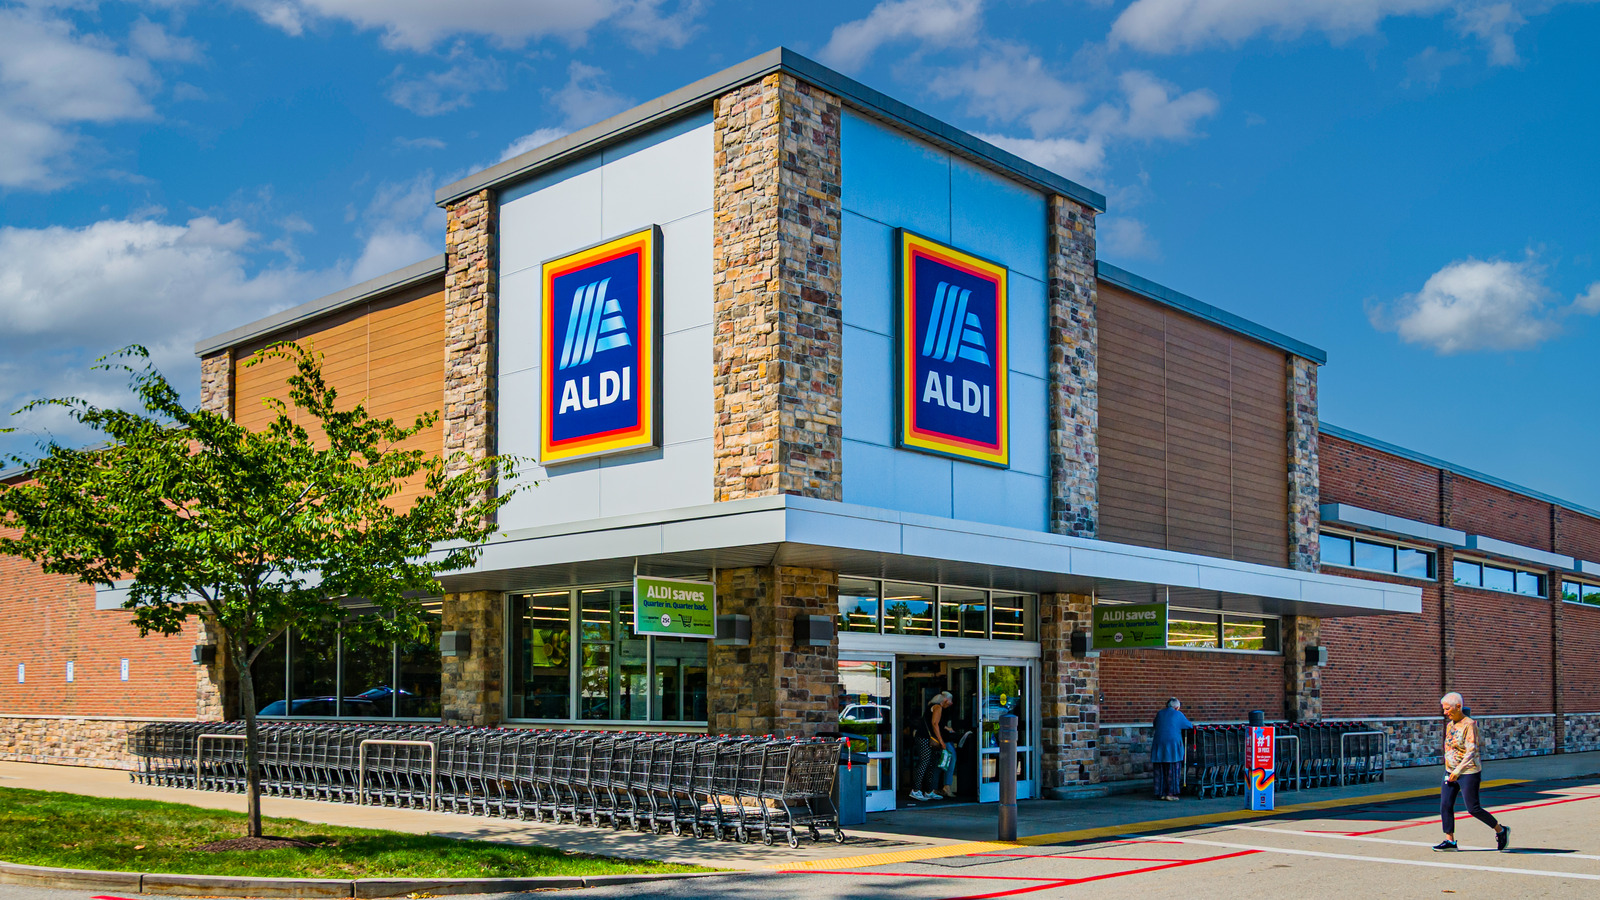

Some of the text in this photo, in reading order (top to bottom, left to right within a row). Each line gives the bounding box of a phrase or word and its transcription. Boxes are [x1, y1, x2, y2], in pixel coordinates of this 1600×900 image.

[559, 366, 630, 414] ALDI
[922, 370, 990, 418] ALDI
[647, 586, 704, 602] ALDI saves
[1103, 611, 1156, 621] ALDI saves
[1257, 735, 1270, 746] #1
